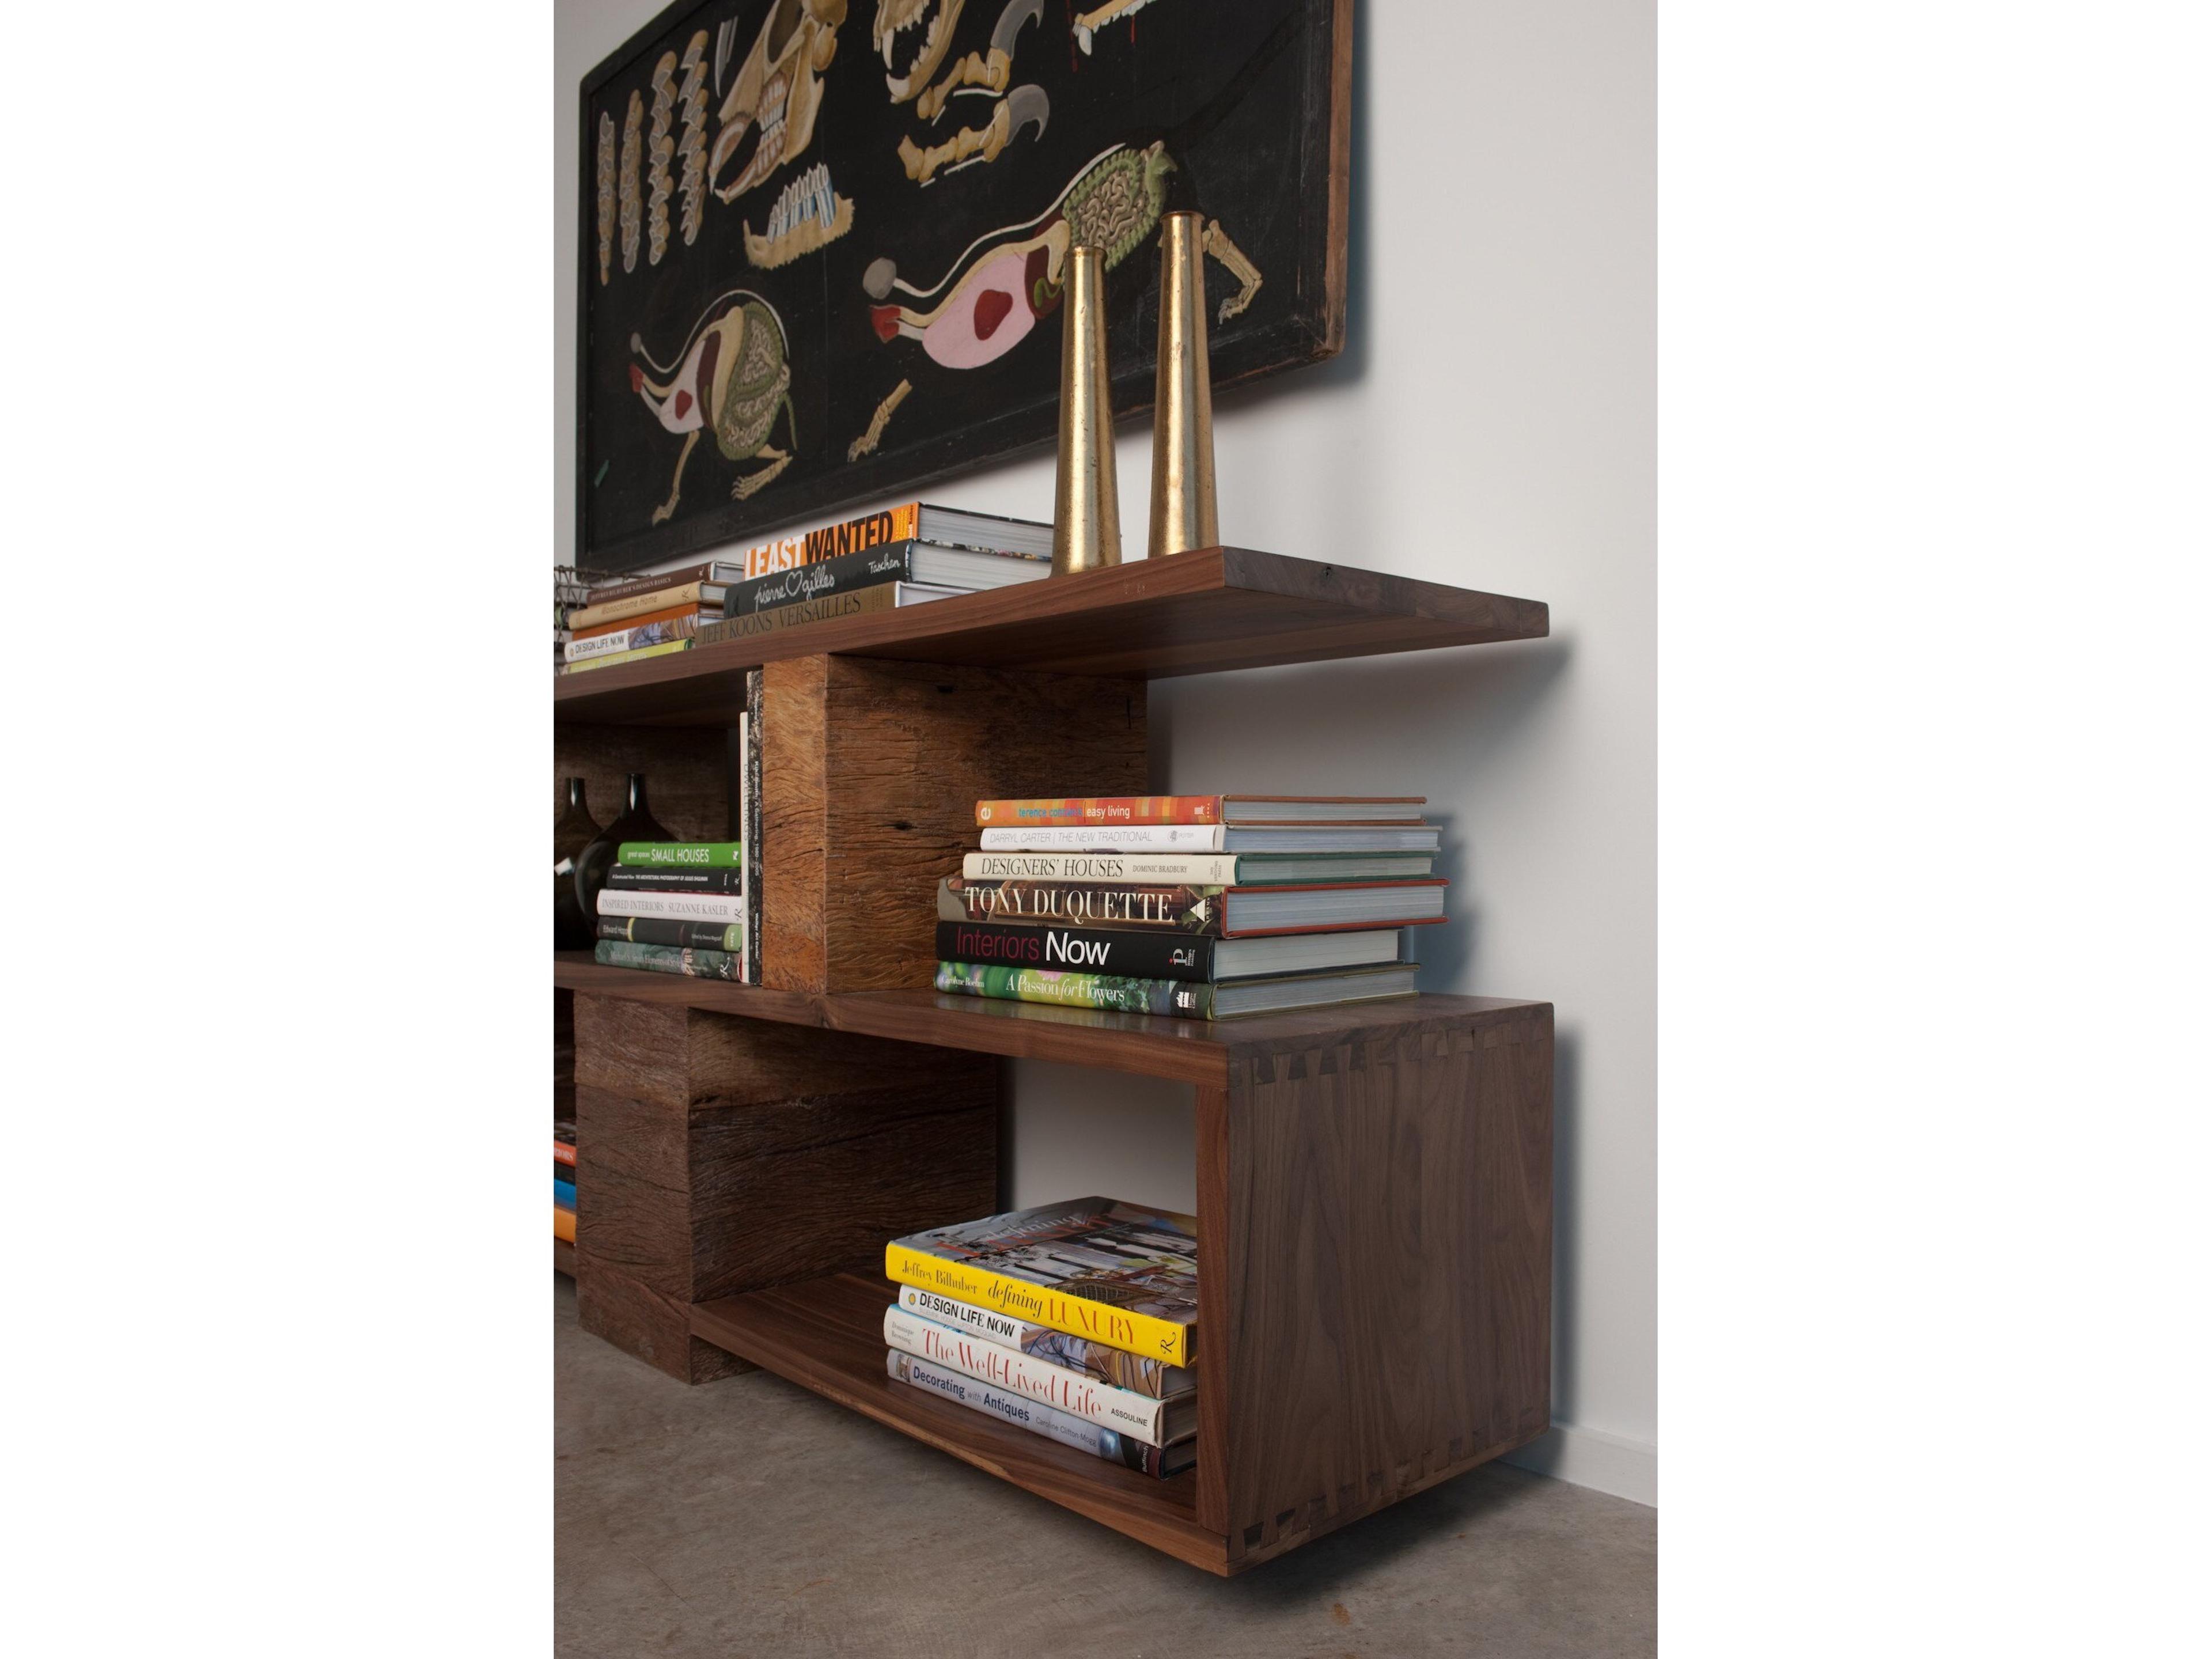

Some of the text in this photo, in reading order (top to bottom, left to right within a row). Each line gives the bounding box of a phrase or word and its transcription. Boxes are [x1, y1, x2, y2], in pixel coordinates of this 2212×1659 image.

[745, 535, 806, 581] LEAST
[805, 511, 893, 564] WANTED
[869, 553, 900, 574] Taschen
[639, 596, 657, 606] Home
[755, 583, 786, 612] pierre
[802, 565, 835, 601] gilles
[702, 626, 726, 645] JEFF
[729, 613, 772, 638] KOONS
[779, 592, 861, 627] VERSAILLES
[575, 634, 624, 654] DESIGN LIFE NOW
[1018, 808, 1046, 817] terence
[1086, 808, 1105, 819] easy
[1108, 805, 1130, 819] living
[990, 831, 1153, 843] DARRYL CARTER THE NEW TRADITIONAL
[652, 849, 675, 862] SMALL
[677, 849, 710, 863] HOUSES
[1064, 858, 1124, 877] HOUSES
[1132, 864, 1158, 873] DOMINIC
[1158, 865, 1188, 874] BRADBURY
[602, 899, 729, 916] INSPIRED INTERIORS SUZANNE KASLER
[965, 887, 1173, 925] TONY DUQUETTE
[956, 926, 1111, 965] Interiors Now
[965, 977, 984, 988] Roehm
[1006, 973, 1125, 1002] A Passion for Flowers
[902, 1260, 1135, 1344] Jeffrey Bilhuber defining LUXURY
[919, 1293, 959, 1318] DESIGN
[960, 1307, 986, 1327] LIFE
[987, 1316, 1015, 1337] NOW
[922, 1328, 1148, 1427] The Well-Lived Life ASSOULINE
[914, 1366, 965, 1400] Decorating
[967, 1389, 981, 1402] with
[983, 1393, 1030, 1421] Antiques
[1035, 1416, 1059, 1431] Caroline
